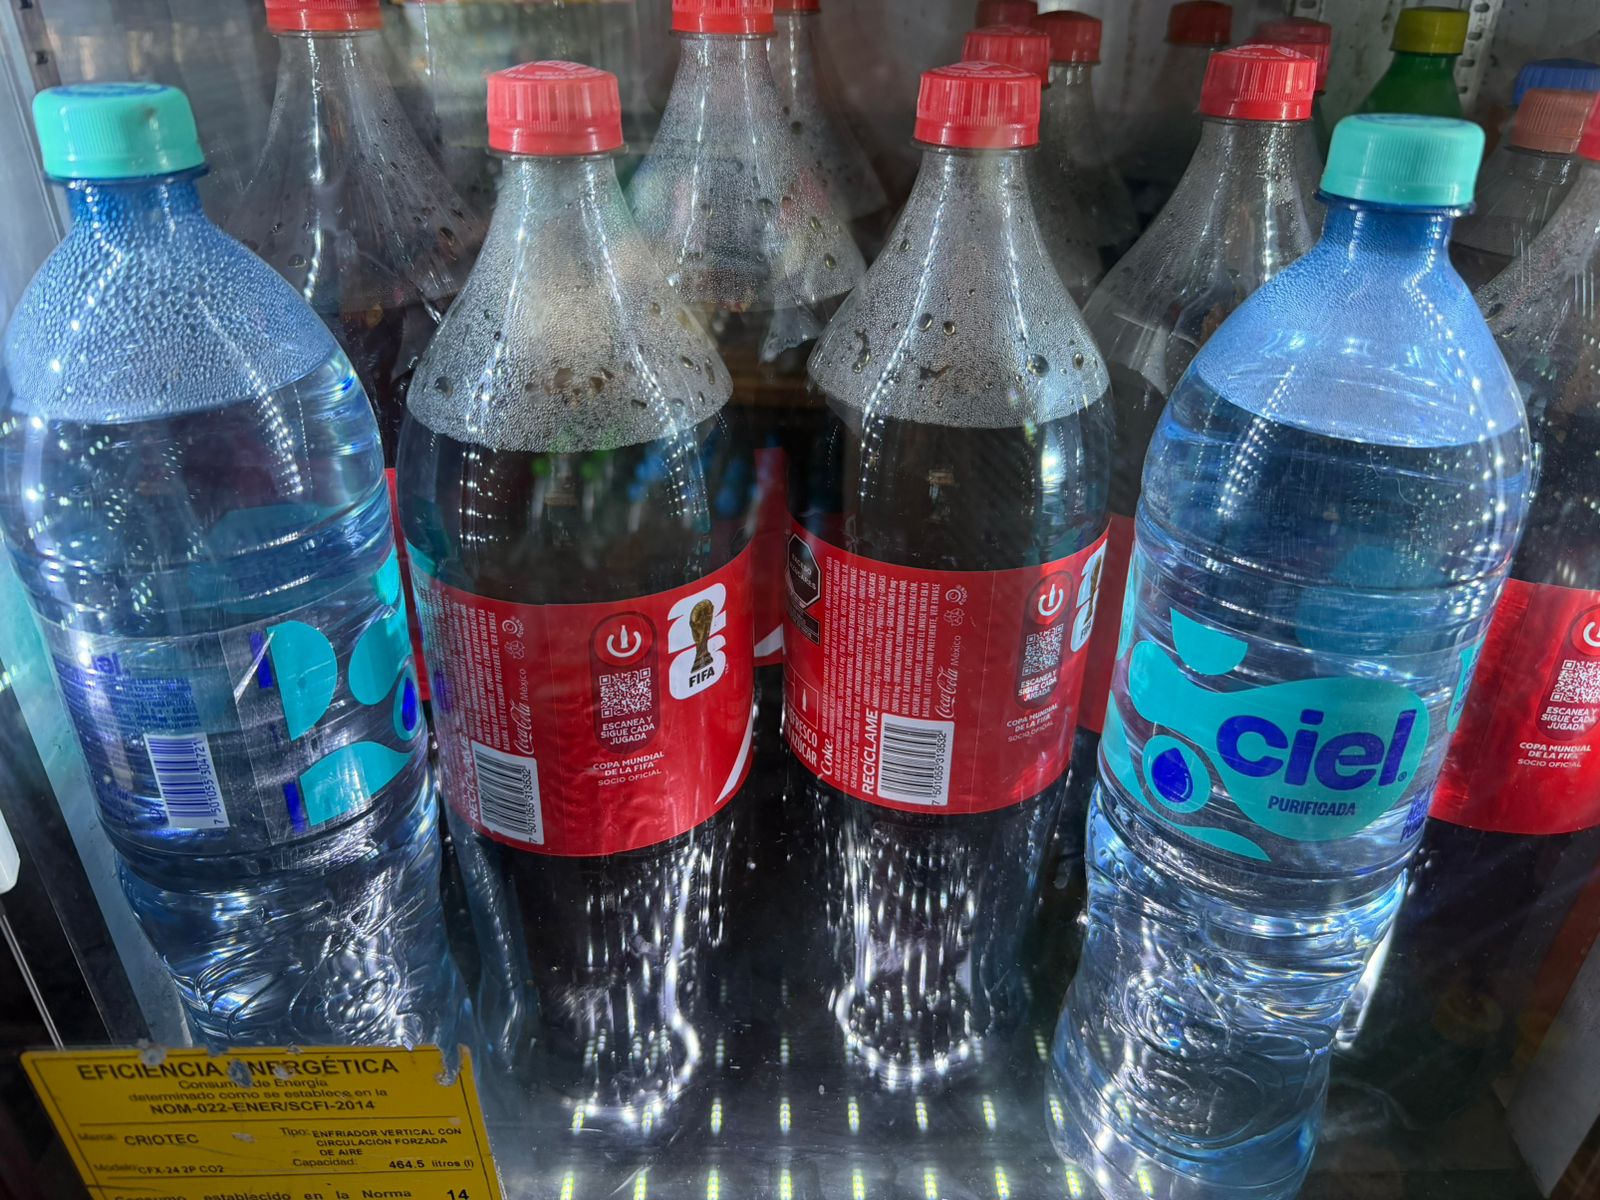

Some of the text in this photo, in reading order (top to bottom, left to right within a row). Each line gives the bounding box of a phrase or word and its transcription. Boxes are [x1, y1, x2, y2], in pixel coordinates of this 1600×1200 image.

[867, 572, 876, 599] AZÚCARES
[878, 574, 886, 594] GRASAS
[931, 583, 940, 604] ENVASE
[887, 592, 896, 608] TRANS
[907, 581, 919, 626] REFRIGERACIÓN.
[918, 597, 928, 612] VACÍO
[886, 608, 894, 627] GRASAS
[930, 605, 938, 615] VER
[487, 610, 497, 633] ENVASE
[917, 613, 927, 631] ENVASE
[490, 634, 499, 645] VER
[904, 636, 914, 669] CONSÉRVESE
[883, 664, 891, 683] GRASAS
[925, 652, 934, 677] CONSUMO
[688, 666, 715, 688] FIFA
[903, 670, 912, 692] ABIERTO
[934, 635, 961, 718] Coca-Cola México
[1021, 669, 1058, 689] ESCANEA Y
[923, 682, 932, 695] LOTE
[1018, 676, 1058, 697] SIGUE CADA
[1023, 687, 1051, 702] JUGADA
[902, 692, 910, 703] VEZ
[922, 696, 931, 718] BASURA.
[509, 668, 535, 755] Coca-Cola México
[1006, 703, 1059, 728] COPA MUNDIAL
[1540, 713, 1598, 724] SIGUE CADA
[1546, 706, 1589, 716] ESCANEA
[600, 723, 655, 739] SIGUE CADA
[602, 715, 653, 731] ESCANEA Y
[1007, 722, 1055, 743] SOCIO OFICIAL
[1015, 714, 1051, 733] DE LA FIFA
[1547, 722, 1585, 731] JUGADA
[610, 732, 647, 746] JUGADA
[791, 728, 817, 767] AZÚCAR
[935, 732, 947, 764] 313532
[1520, 742, 1591, 753] COPA MUNDIAL
[192, 740, 210, 776] 304721
[820, 738, 833, 776] Coke
[860, 707, 878, 796] RECÍCLAME
[1216, 709, 1419, 791] ciel
[1528, 750, 1542, 758] DE
[1543, 751, 1556, 759] LA
[593, 751, 665, 771] COPA MUNDIAL
[1517, 758, 1547, 767] SOCIO
[598, 768, 662, 786] SOCIO OFICIAL
[604, 767, 618, 777] DE
[619, 765, 632, 774] LA
[932, 765, 944, 795] 501055
[521, 769, 534, 801] 313532
[204, 780, 222, 813] 501055
[1267, 796, 1357, 817] PURIFICADA
[524, 803, 537, 834] 501055
[77, 1056, 399, 1081] EFICIENCIA NERGÉTICA
[178, 1078, 328, 1089] Consum de Energía
[128, 1088, 388, 1102] determinado como se establece en la
[150, 1100, 375, 1115] NOM-022-ENER/SCFI-2014
[124, 1133, 200, 1146] CRIOTEC
[279, 1127, 462, 1139] Tipo: ENFRIADOR VERTICAL CON
[316, 1137, 448, 1147] CIRCULACIÓN FORZADA
[319, 1148, 363, 1157] DE AIRE
[138, 1166, 180, 1174] CFX-24
[183, 1166, 197, 1174] 2P
[199, 1165, 225, 1173] CO2
[292, 1157, 358, 1168] Capacidad:
[389, 1160, 425, 1169] 464.5
[431, 1159, 461, 1168] litros
[336, 1190, 350, 1200] la
[361, 1190, 412, 1199] Norma
[447, 1189, 470, 1200] 14
